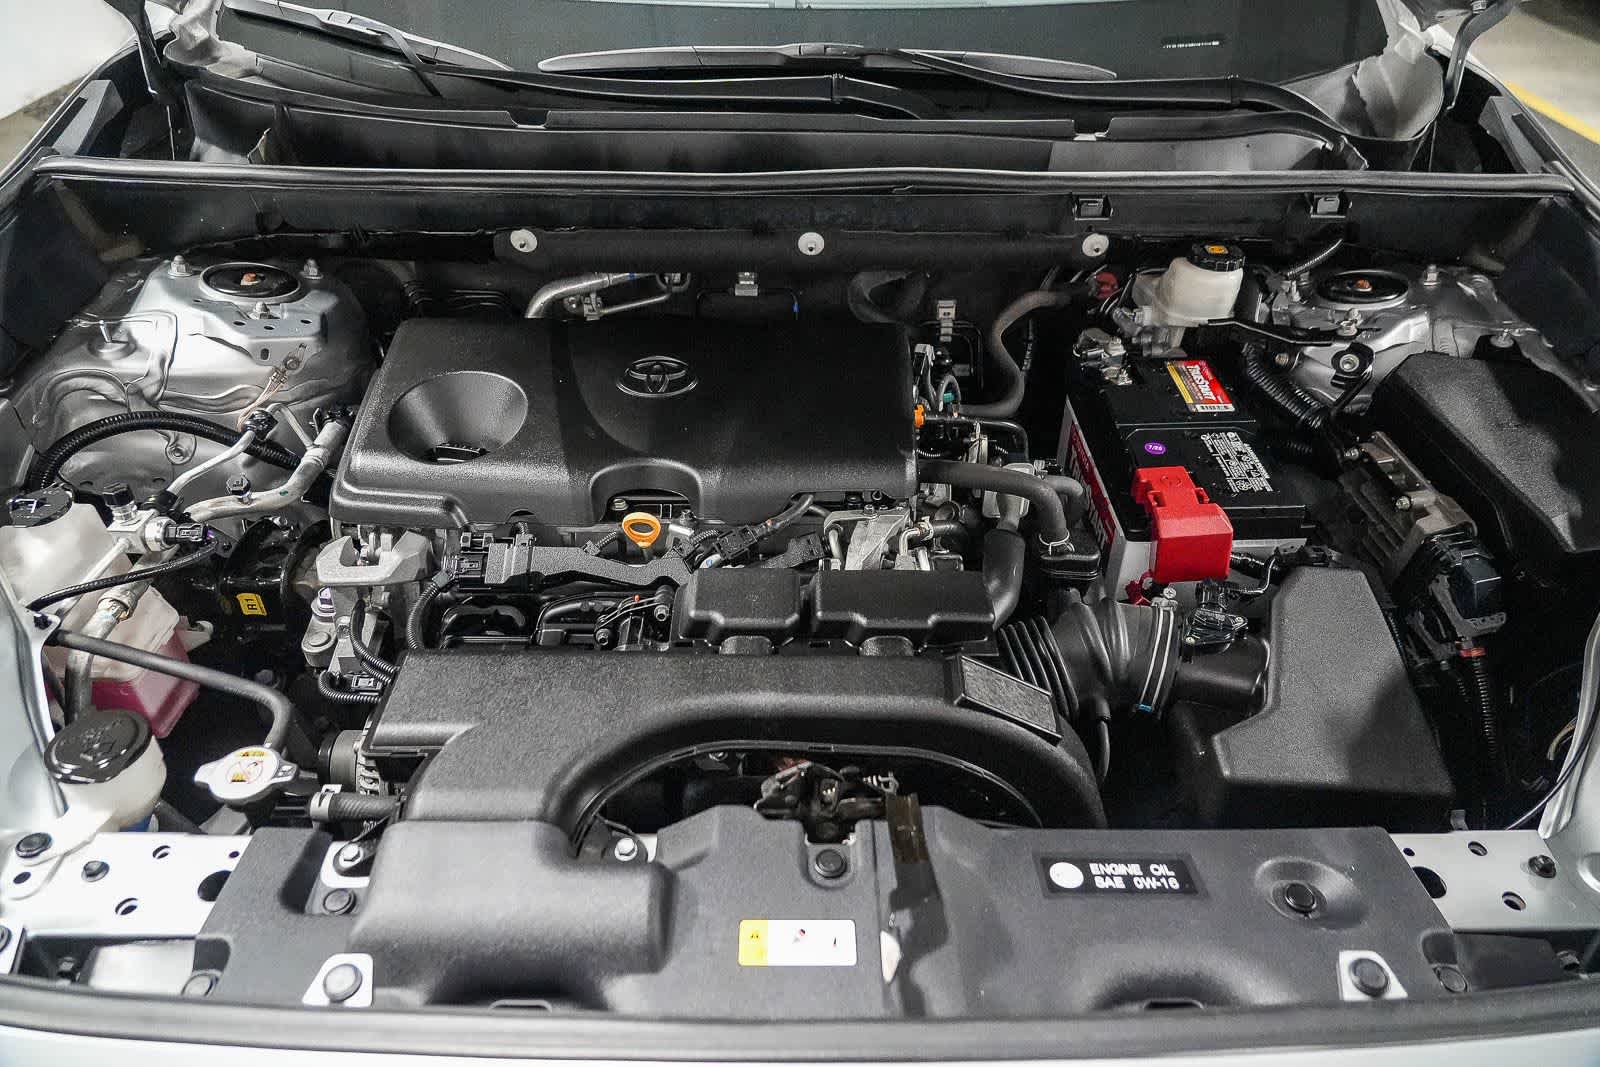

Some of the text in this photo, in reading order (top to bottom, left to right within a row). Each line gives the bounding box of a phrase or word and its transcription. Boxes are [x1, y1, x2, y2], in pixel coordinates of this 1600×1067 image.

[1088, 863, 1176, 877] ENGINE OIL
[1094, 875, 1180, 890] SAE 0W-16
